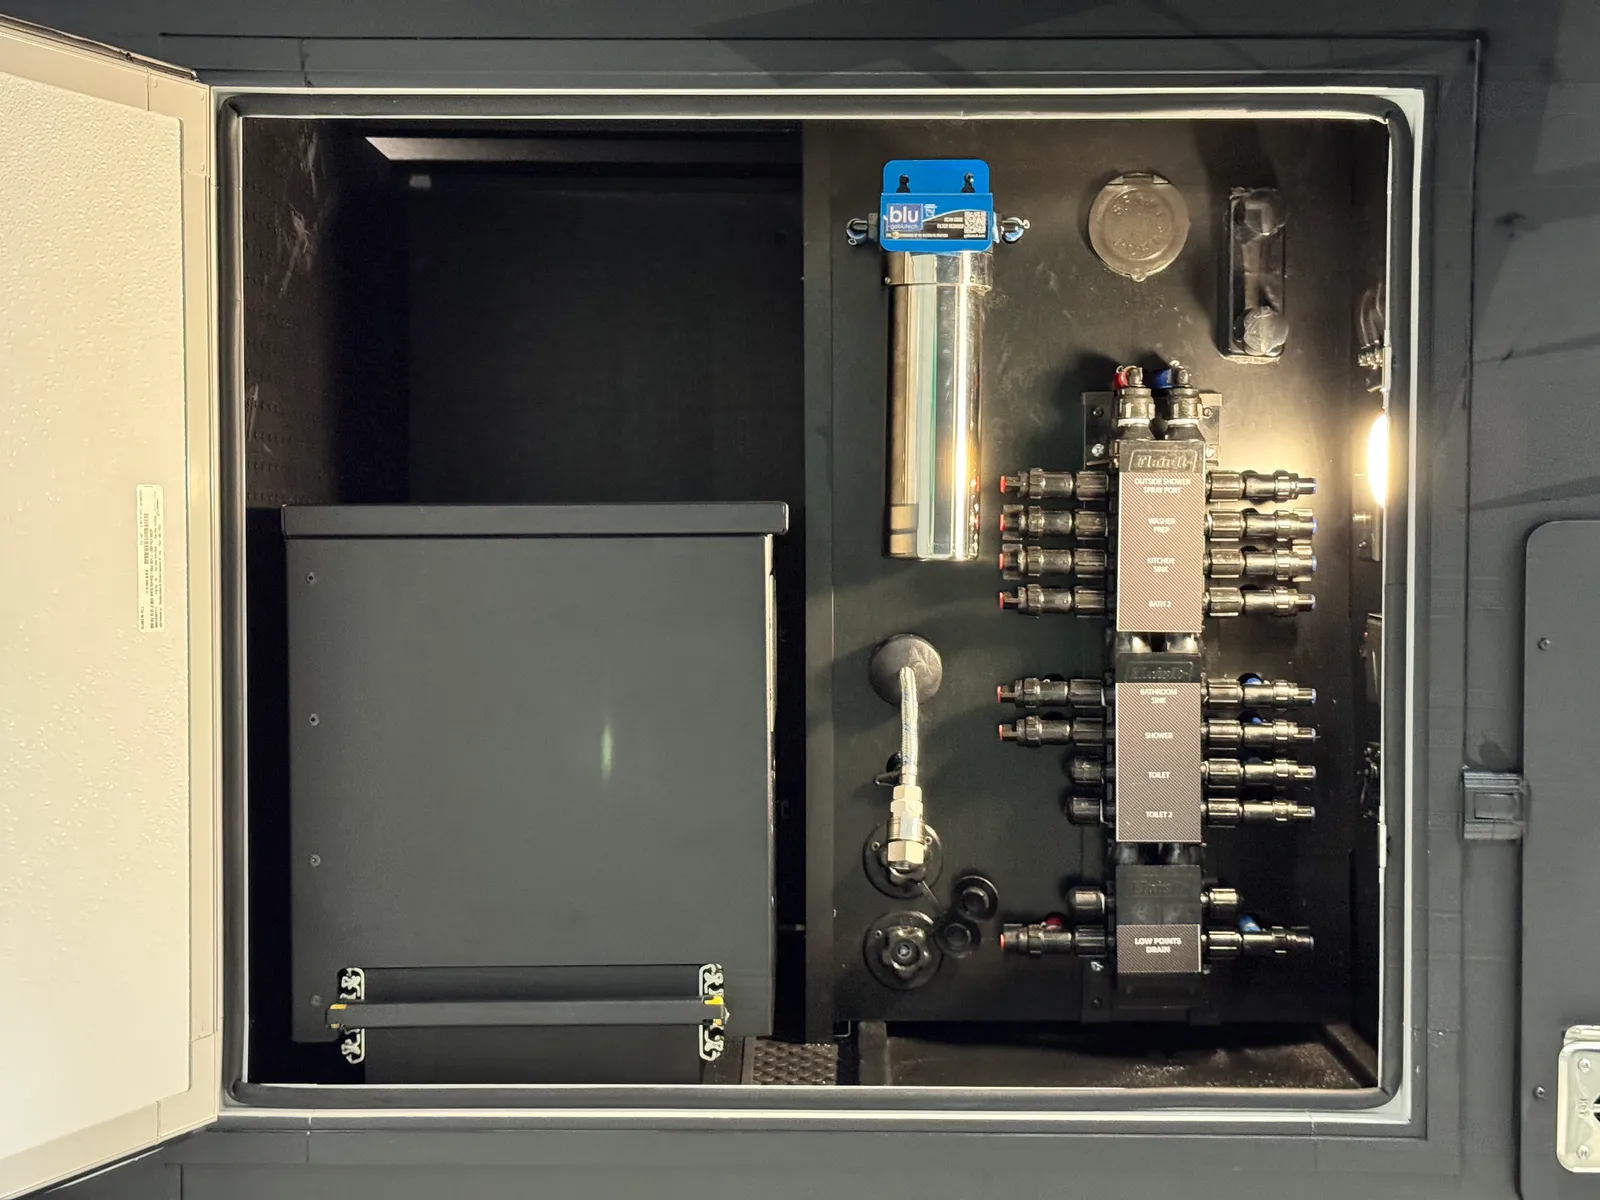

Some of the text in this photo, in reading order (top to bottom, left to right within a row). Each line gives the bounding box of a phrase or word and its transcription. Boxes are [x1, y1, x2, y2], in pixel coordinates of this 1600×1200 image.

[889, 206, 919, 223] blu
[1143, 486, 1182, 494] SPRAY PORT
[1148, 517, 1176, 525] WASHER
[1153, 526, 1170, 534] PREP
[1147, 557, 1176, 565] KITCHEN
[1153, 565, 1169, 573] SINK
[1148, 600, 1172, 608] BATH 2
[1140, 688, 1178, 696] BATHROOM
[1151, 696, 1167, 704] SINK
[1144, 731, 1174, 739] SHOWER
[1147, 771, 1171, 779] TOILET
[1145, 810, 1173, 818] TOILET 2
[1134, 937, 1182, 945] LOW POINTS
[1145, 946, 1171, 954] DRAIN
